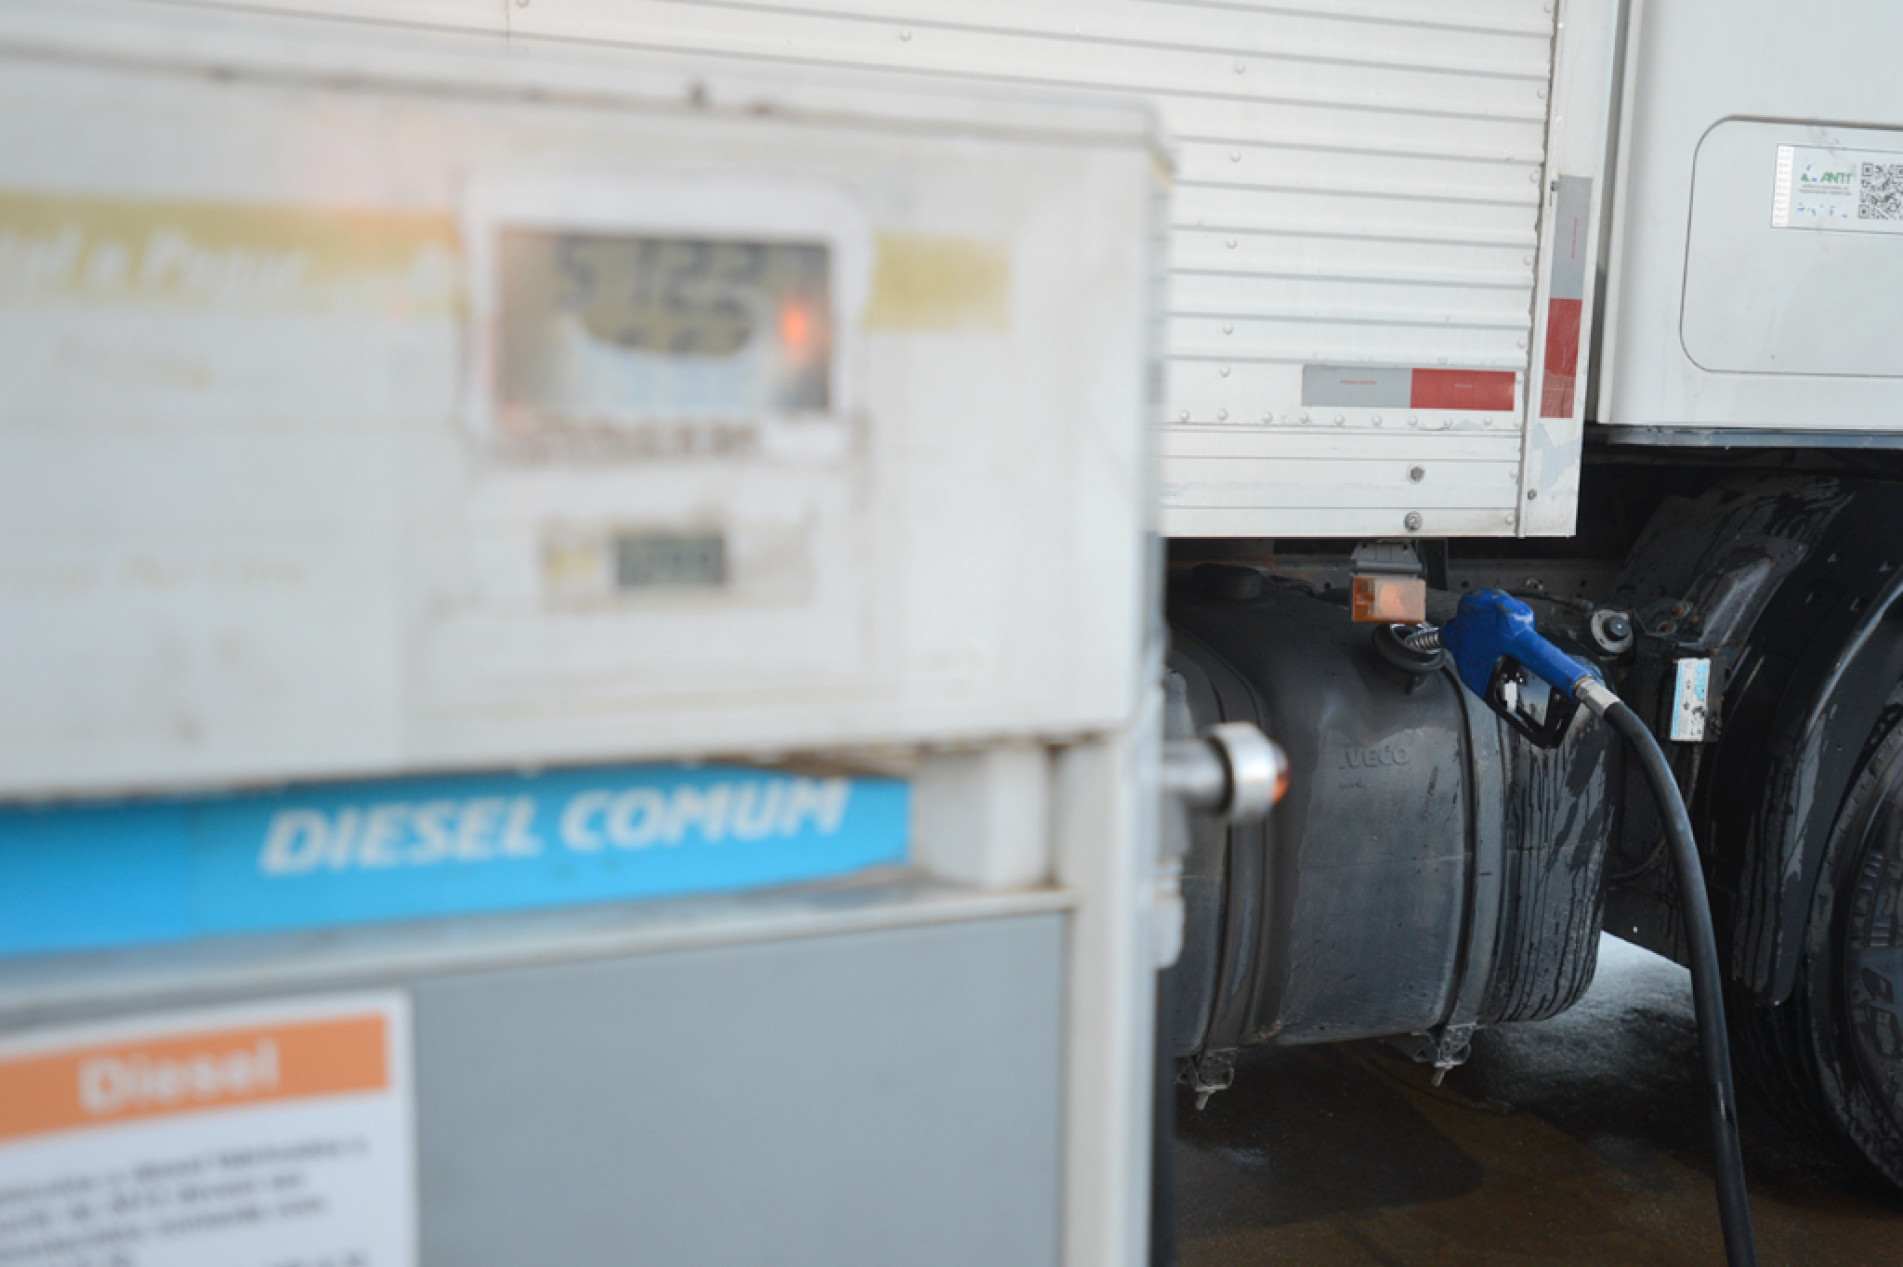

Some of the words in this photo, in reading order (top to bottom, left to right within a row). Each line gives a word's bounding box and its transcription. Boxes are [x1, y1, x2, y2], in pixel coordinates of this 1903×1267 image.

[1820, 172, 1853, 184] ANTT
[262, 798, 542, 873] DIESEL
[563, 778, 849, 851] COMUM
[79, 1040, 280, 1114] Diesel
